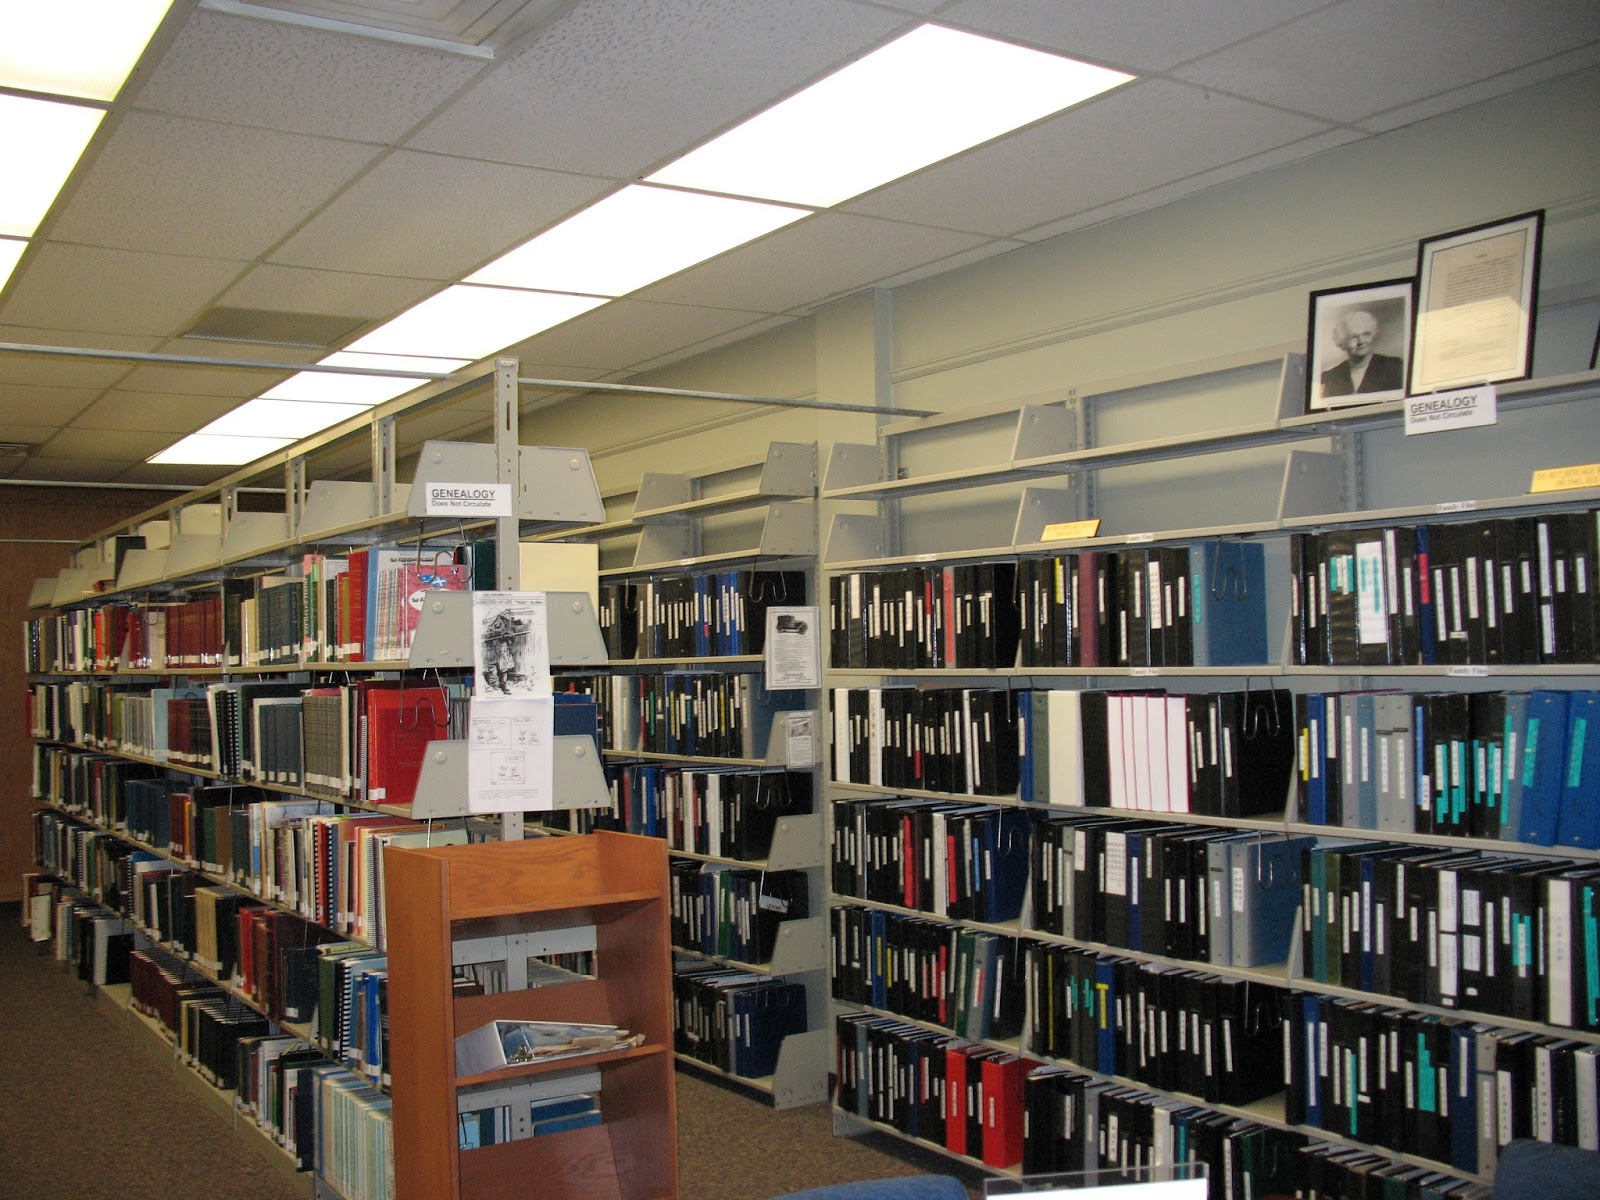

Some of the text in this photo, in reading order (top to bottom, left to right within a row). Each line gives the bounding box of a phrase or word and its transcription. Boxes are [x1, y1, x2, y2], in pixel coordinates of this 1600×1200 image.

[1411, 395, 1477, 413] GENEALOGY
[1443, 410, 1473, 419] Circulate
[432, 489, 495, 498] GENEALOGY
